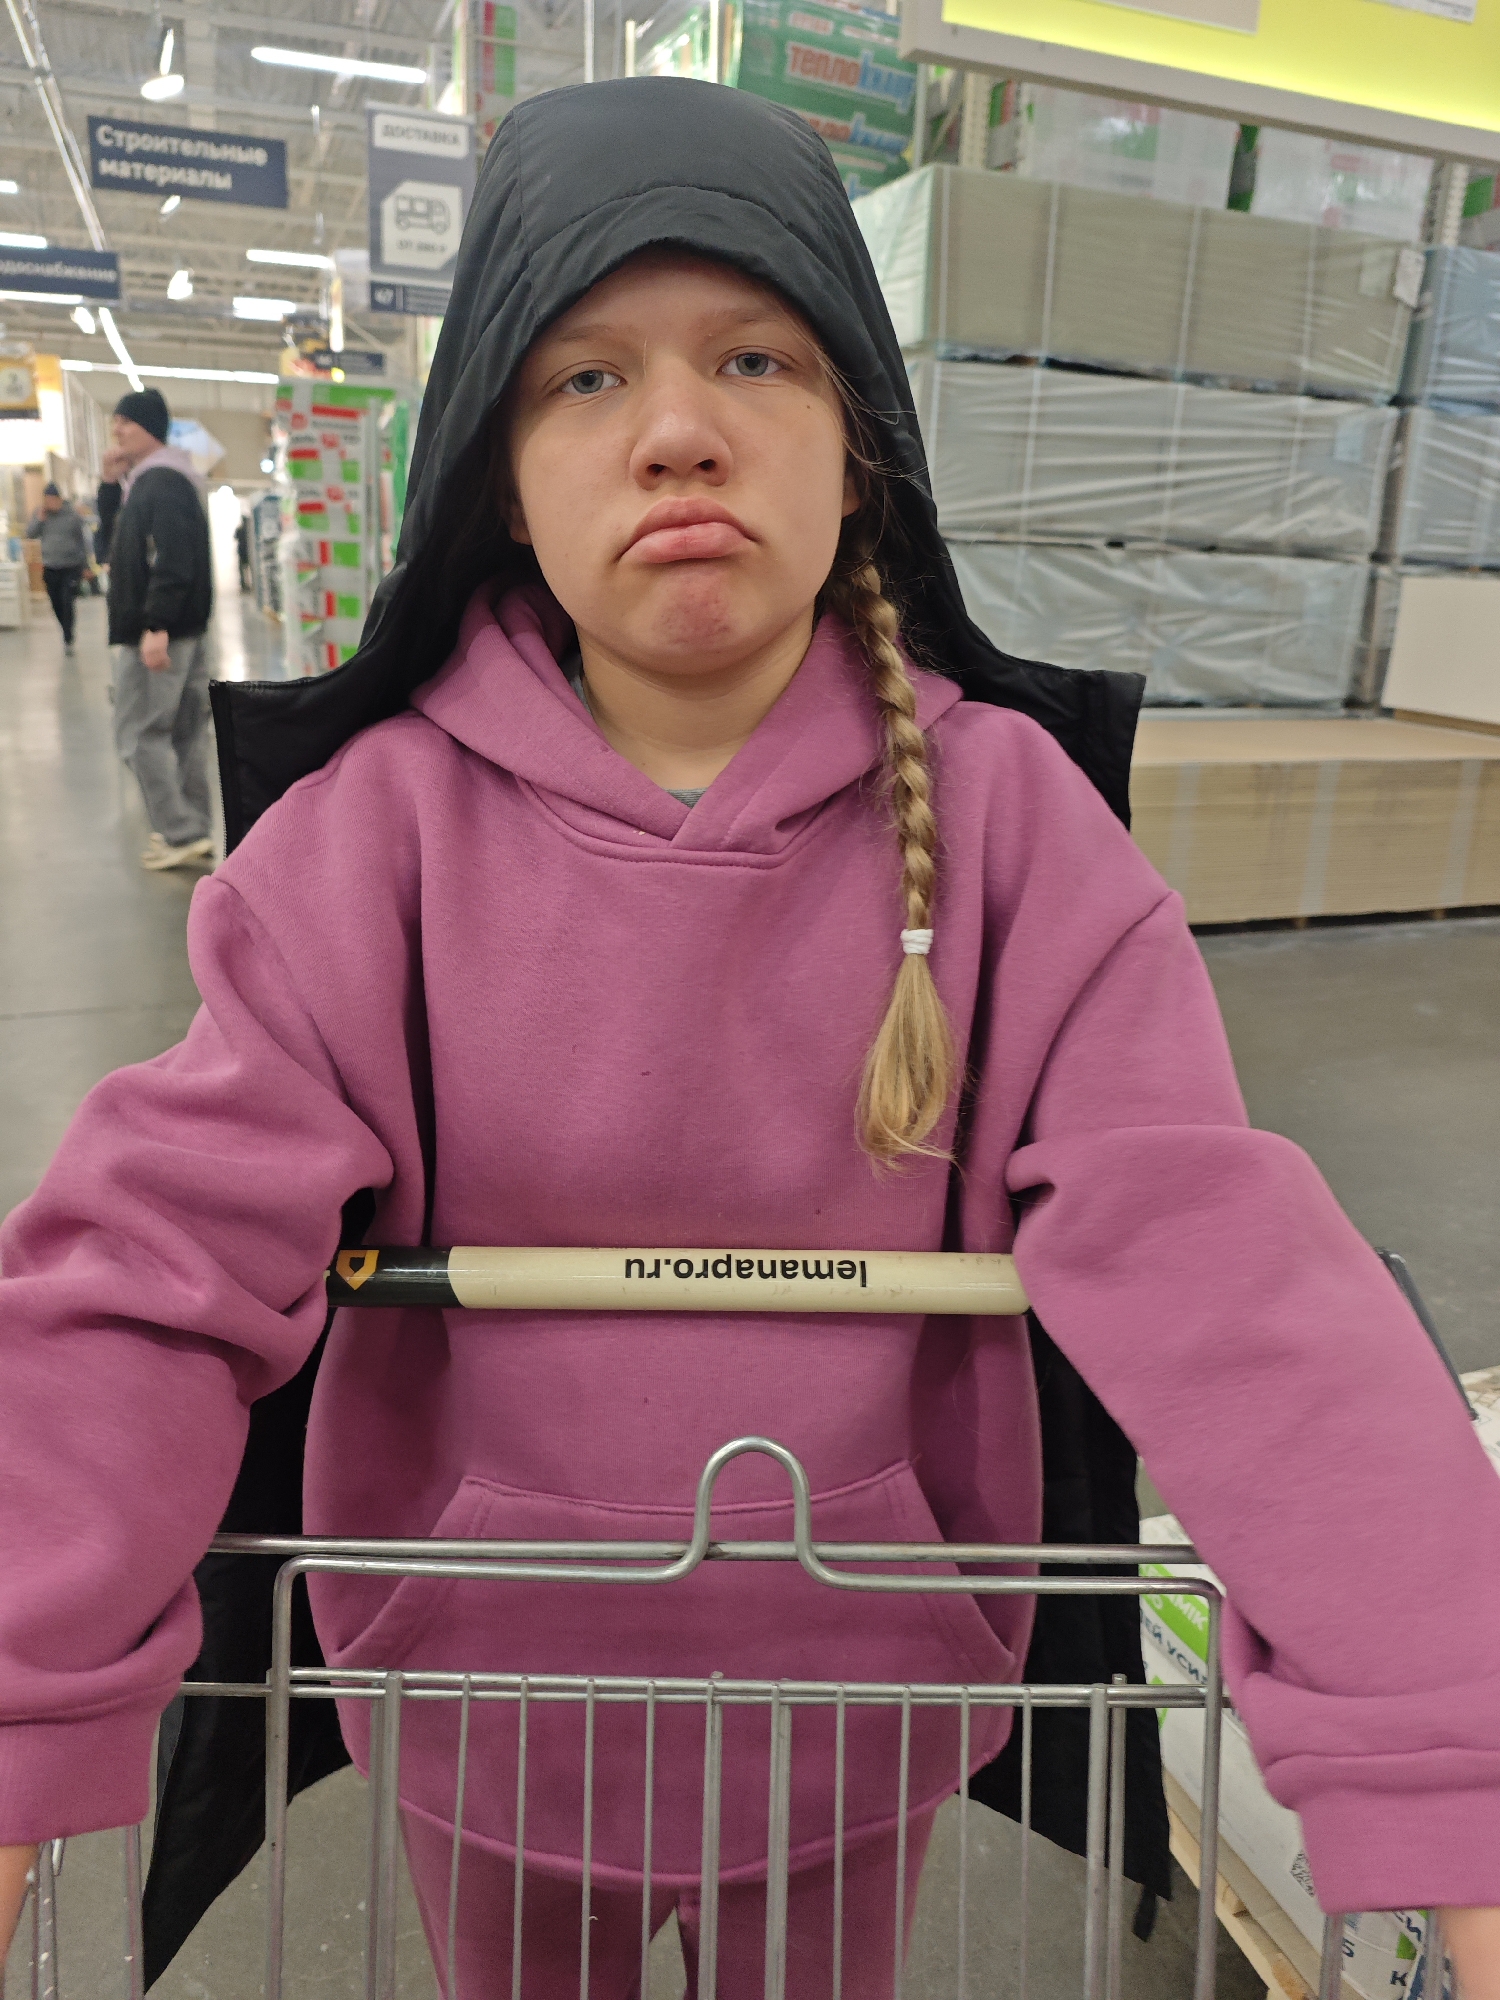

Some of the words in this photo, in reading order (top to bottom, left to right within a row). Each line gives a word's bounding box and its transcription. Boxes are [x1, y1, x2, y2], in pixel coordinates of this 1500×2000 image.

[96, 124, 268, 167] Строительные
[98, 158, 233, 191] материалы
[624, 1253, 868, 1288] lemanapro.ru
